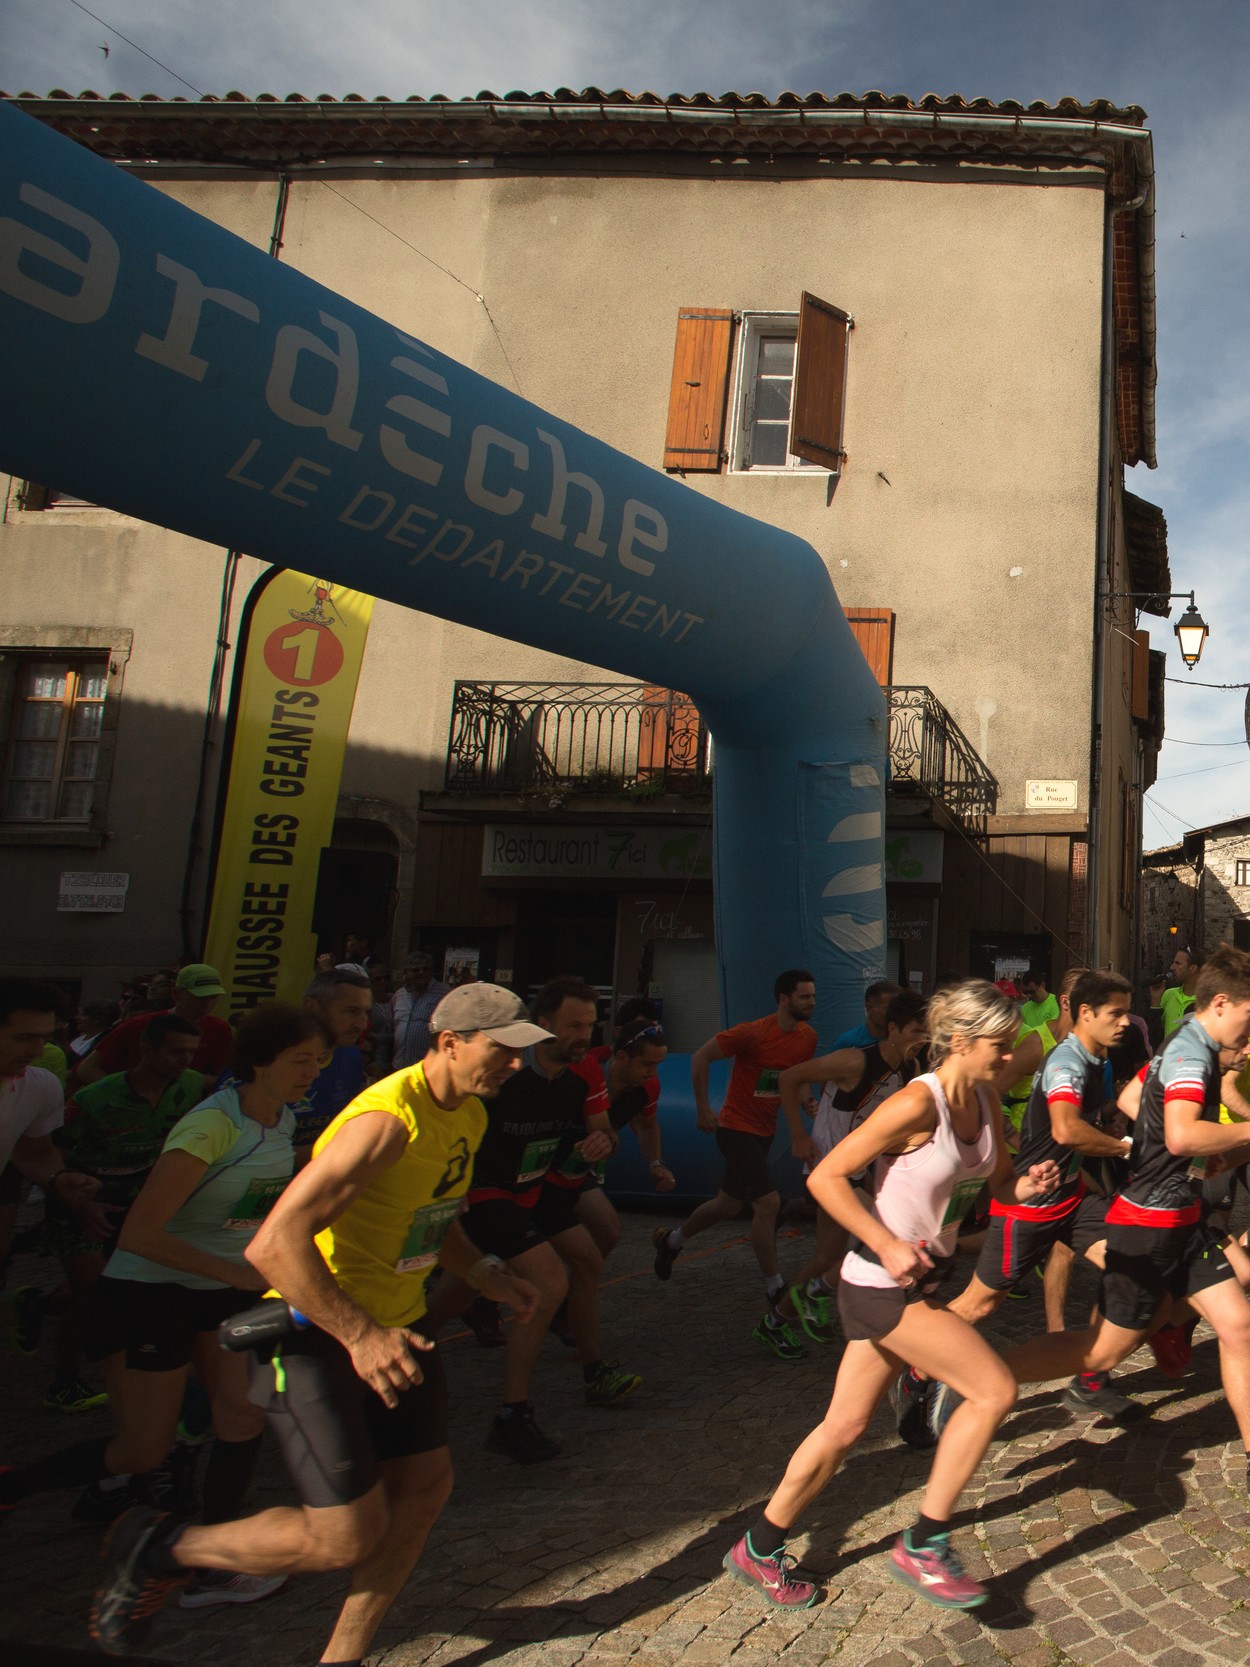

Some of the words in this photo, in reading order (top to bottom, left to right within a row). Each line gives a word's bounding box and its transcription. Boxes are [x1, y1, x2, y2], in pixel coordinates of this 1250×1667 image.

[226, 438, 332, 510] LE
[281, 626, 323, 682] 1
[259, 689, 321, 798] GEANTS
[1047, 795, 1068, 803] Pouget
[249, 813, 300, 867] DES
[493, 830, 599, 865] Restaurant
[228, 882, 290, 1022] HAUSSEE
[499, 972, 509, 980] 19
